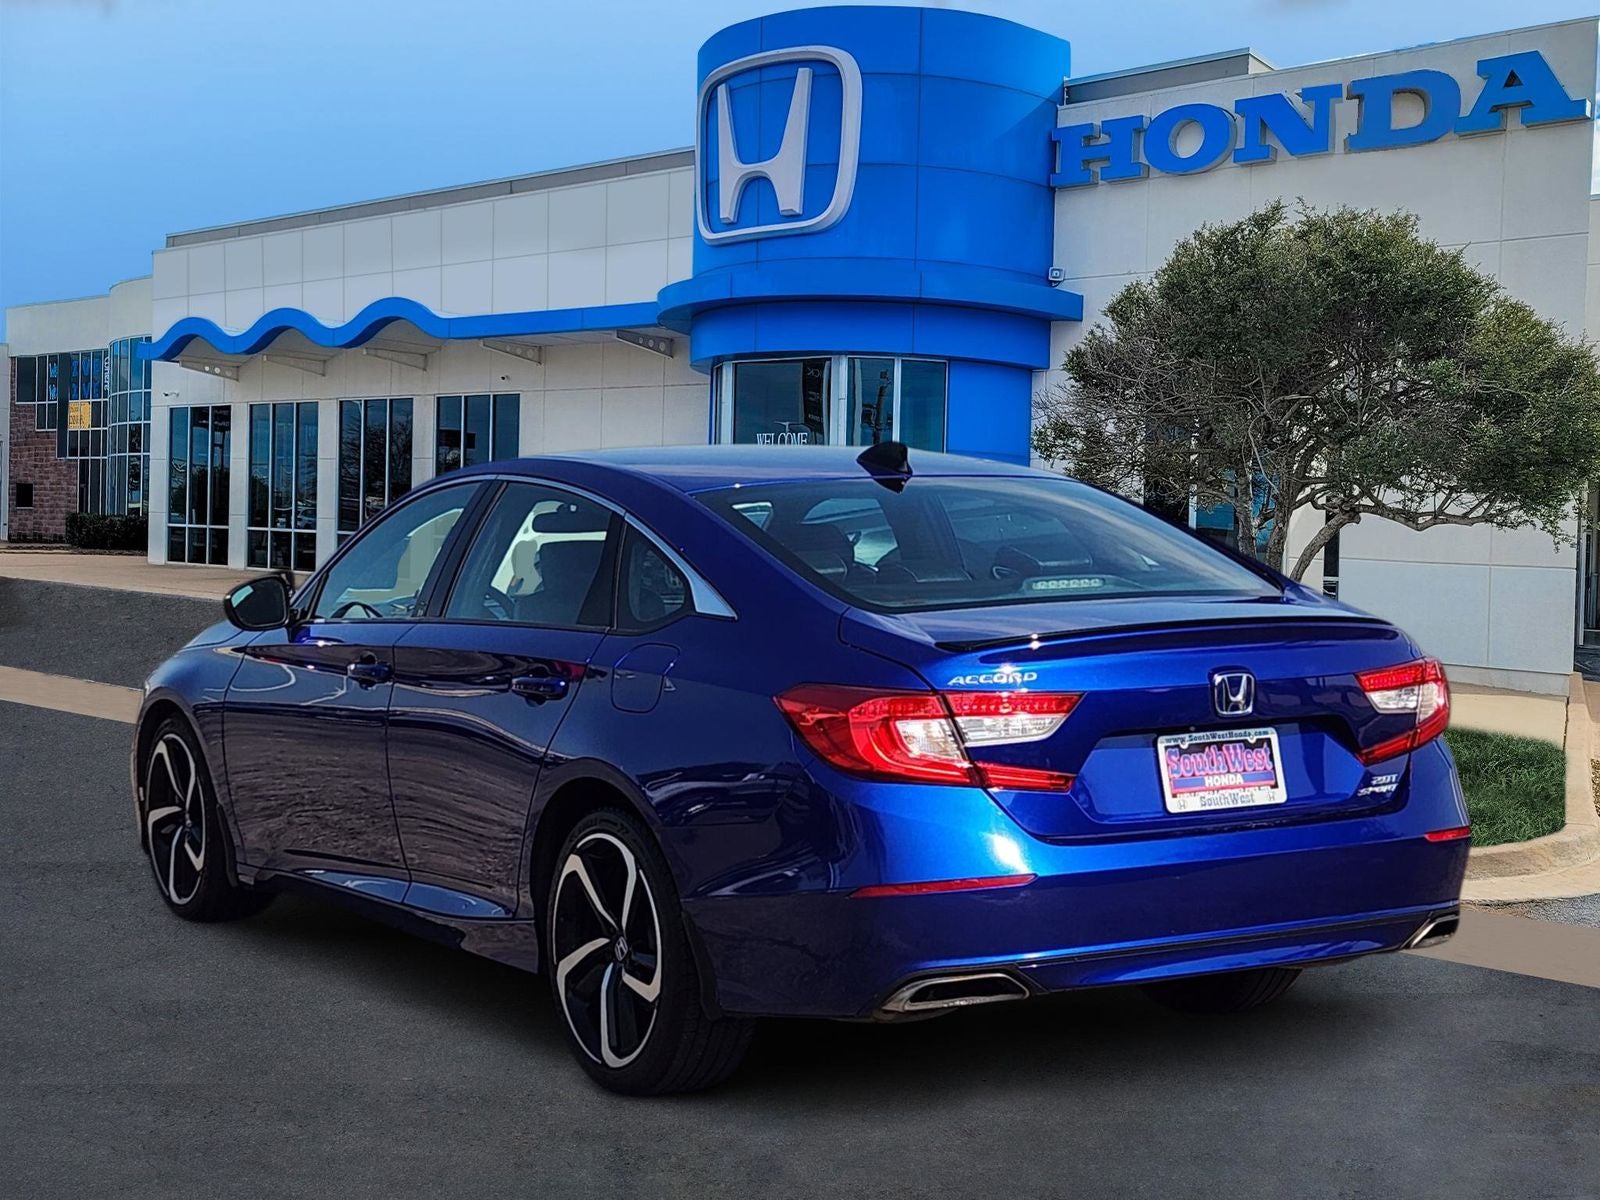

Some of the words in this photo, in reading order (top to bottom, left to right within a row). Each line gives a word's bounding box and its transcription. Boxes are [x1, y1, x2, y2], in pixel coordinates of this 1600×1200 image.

[1050, 50, 1591, 188] HONDA
[947, 672, 1038, 686] ACCORD
[1205, 773, 1244, 786] HONDA
